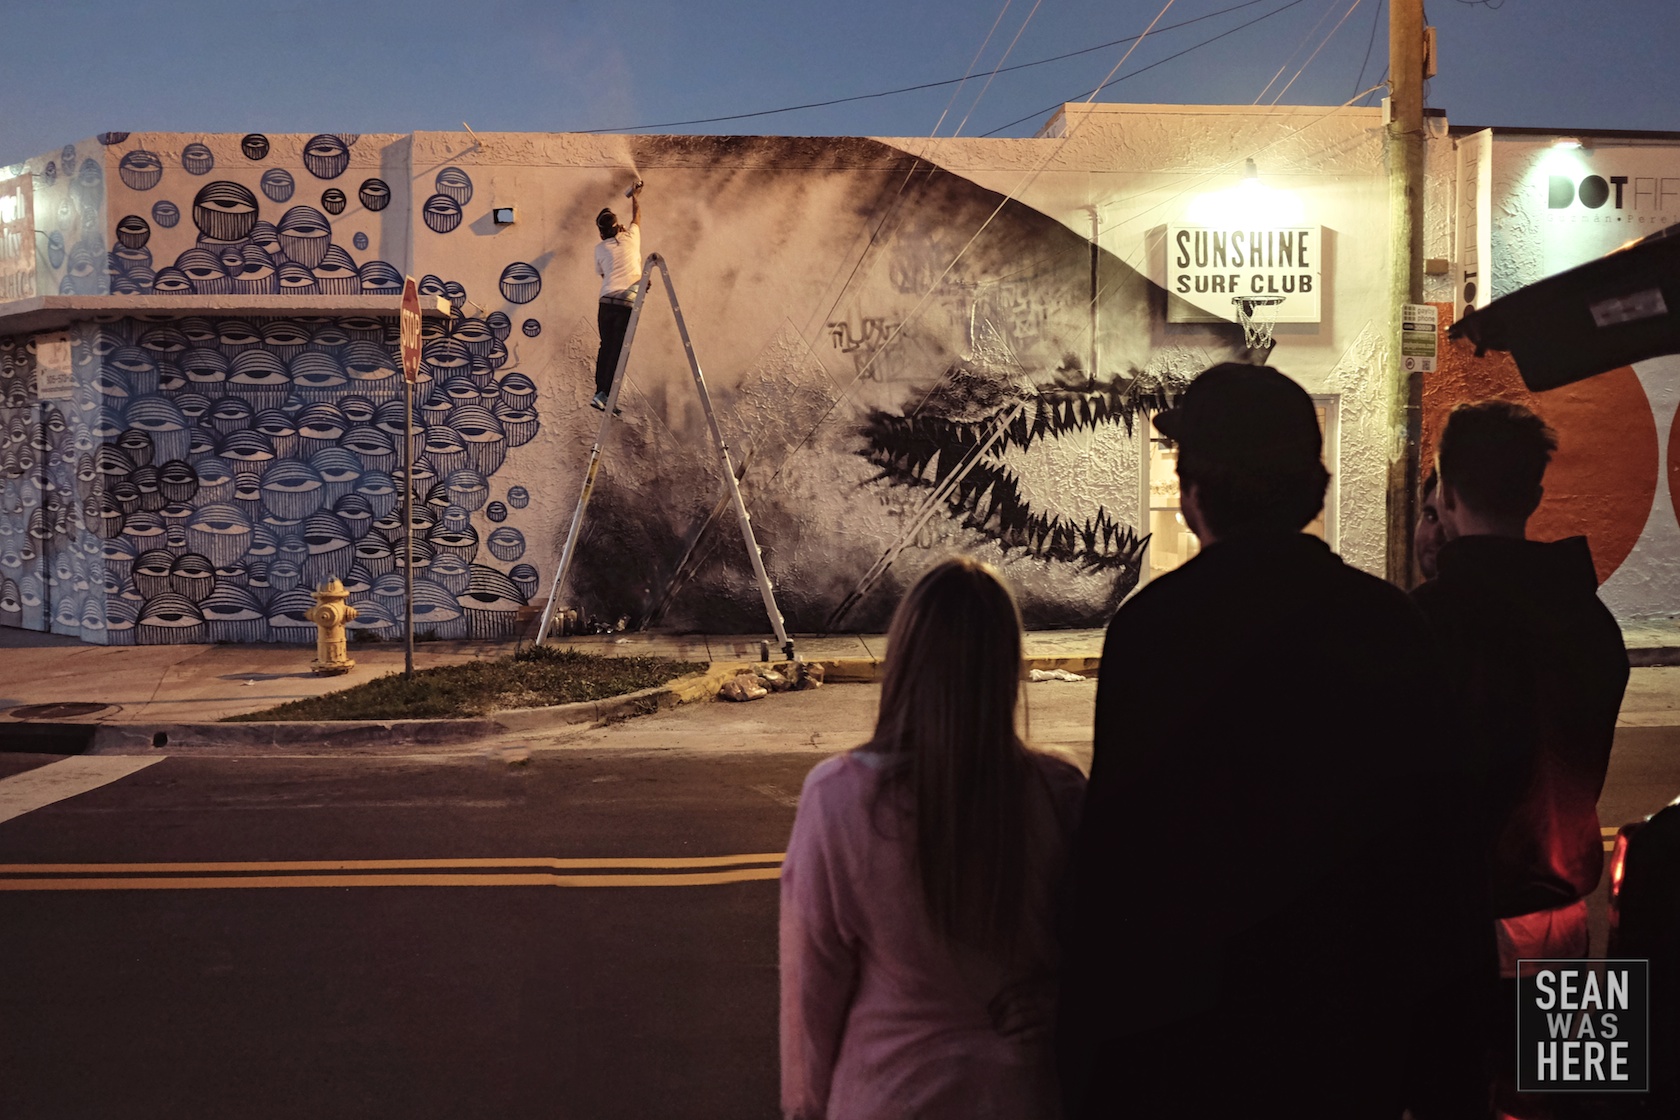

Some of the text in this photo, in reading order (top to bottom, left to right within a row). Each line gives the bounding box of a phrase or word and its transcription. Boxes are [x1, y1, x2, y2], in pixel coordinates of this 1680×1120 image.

[1176, 230, 1310, 268] SUNSHINE
[1176, 274, 1312, 293] SURF CLUB
[402, 308, 420, 350] STOP
